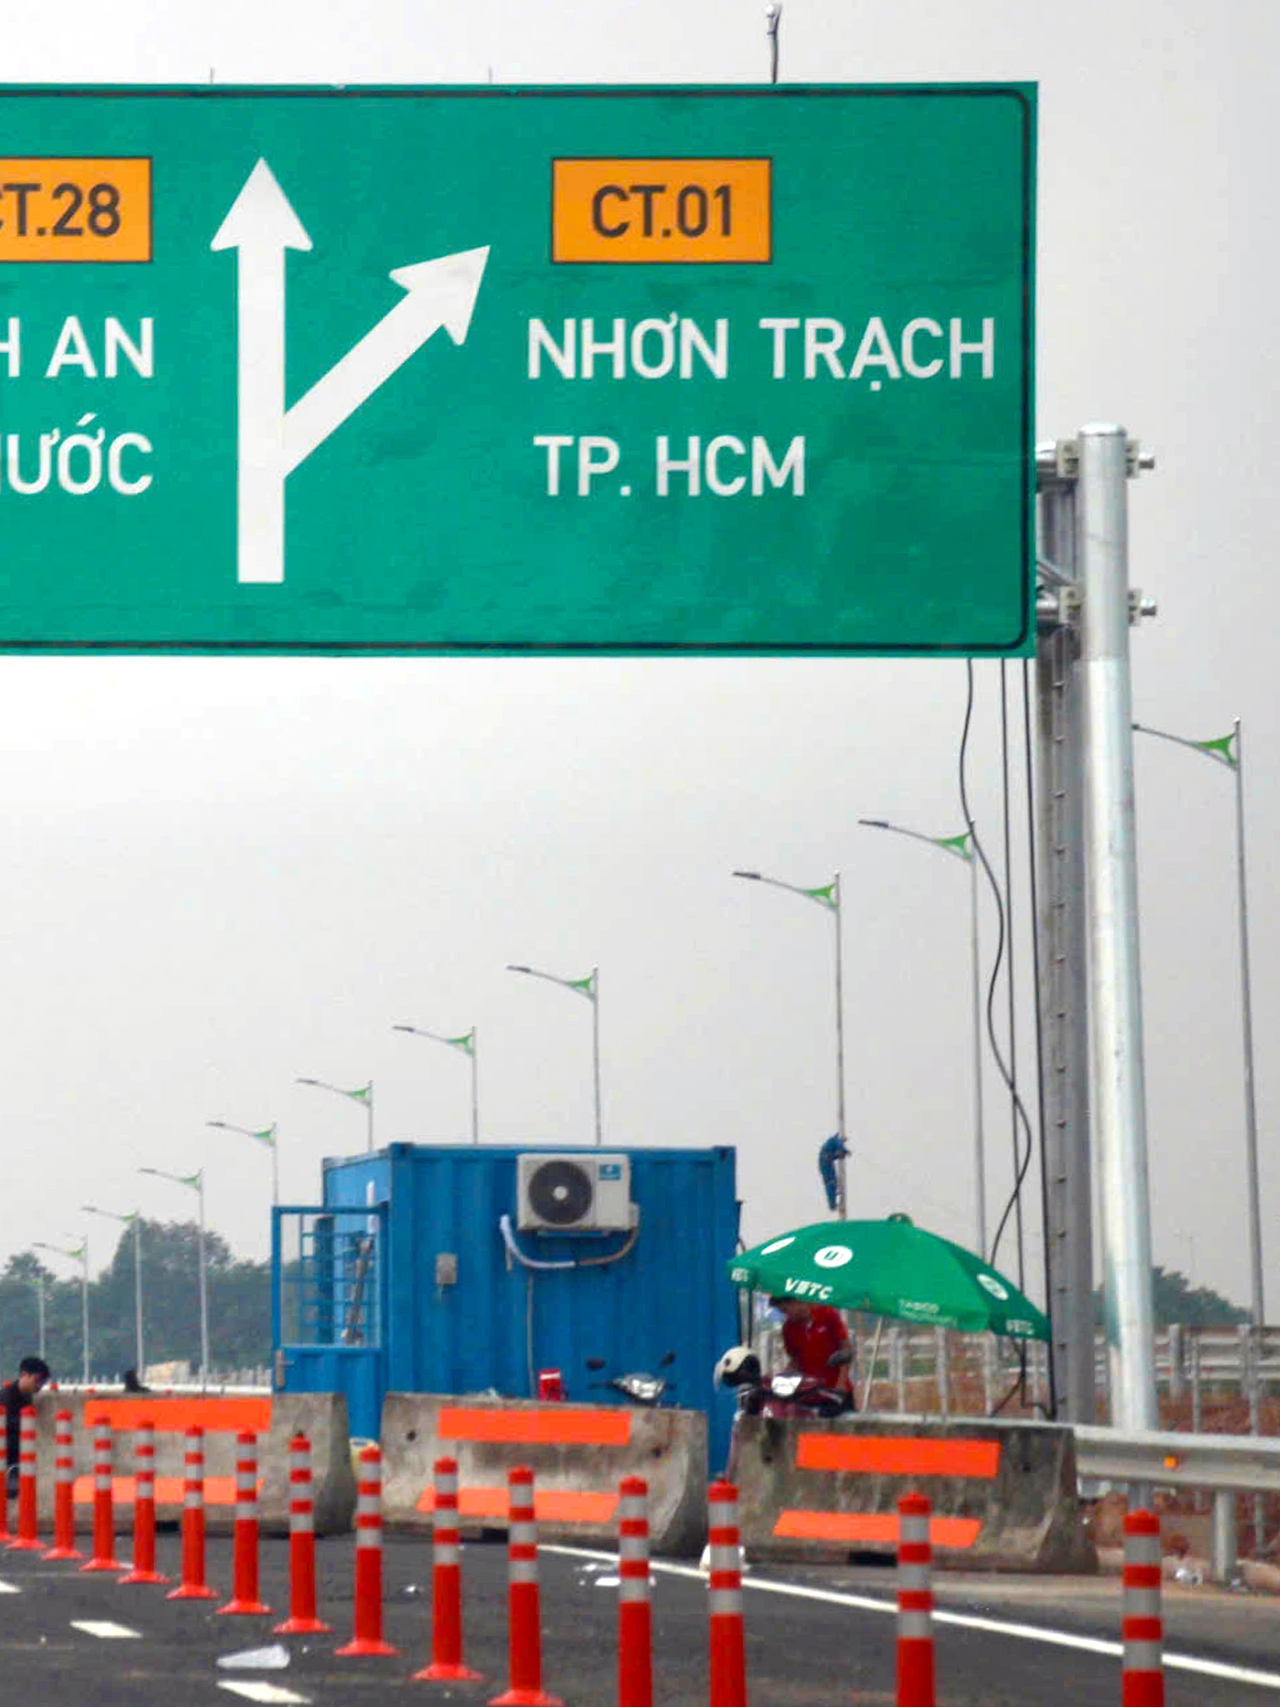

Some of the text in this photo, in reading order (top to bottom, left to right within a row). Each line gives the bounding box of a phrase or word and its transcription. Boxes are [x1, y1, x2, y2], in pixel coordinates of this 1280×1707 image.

[593, 185, 731, 238] CT.01
[46, 316, 153, 378] AN
[528, 313, 994, 391] NHƠN TRẠCH
[533, 435, 805, 496] TP. HCM
[784, 1277, 834, 1301] VETC
